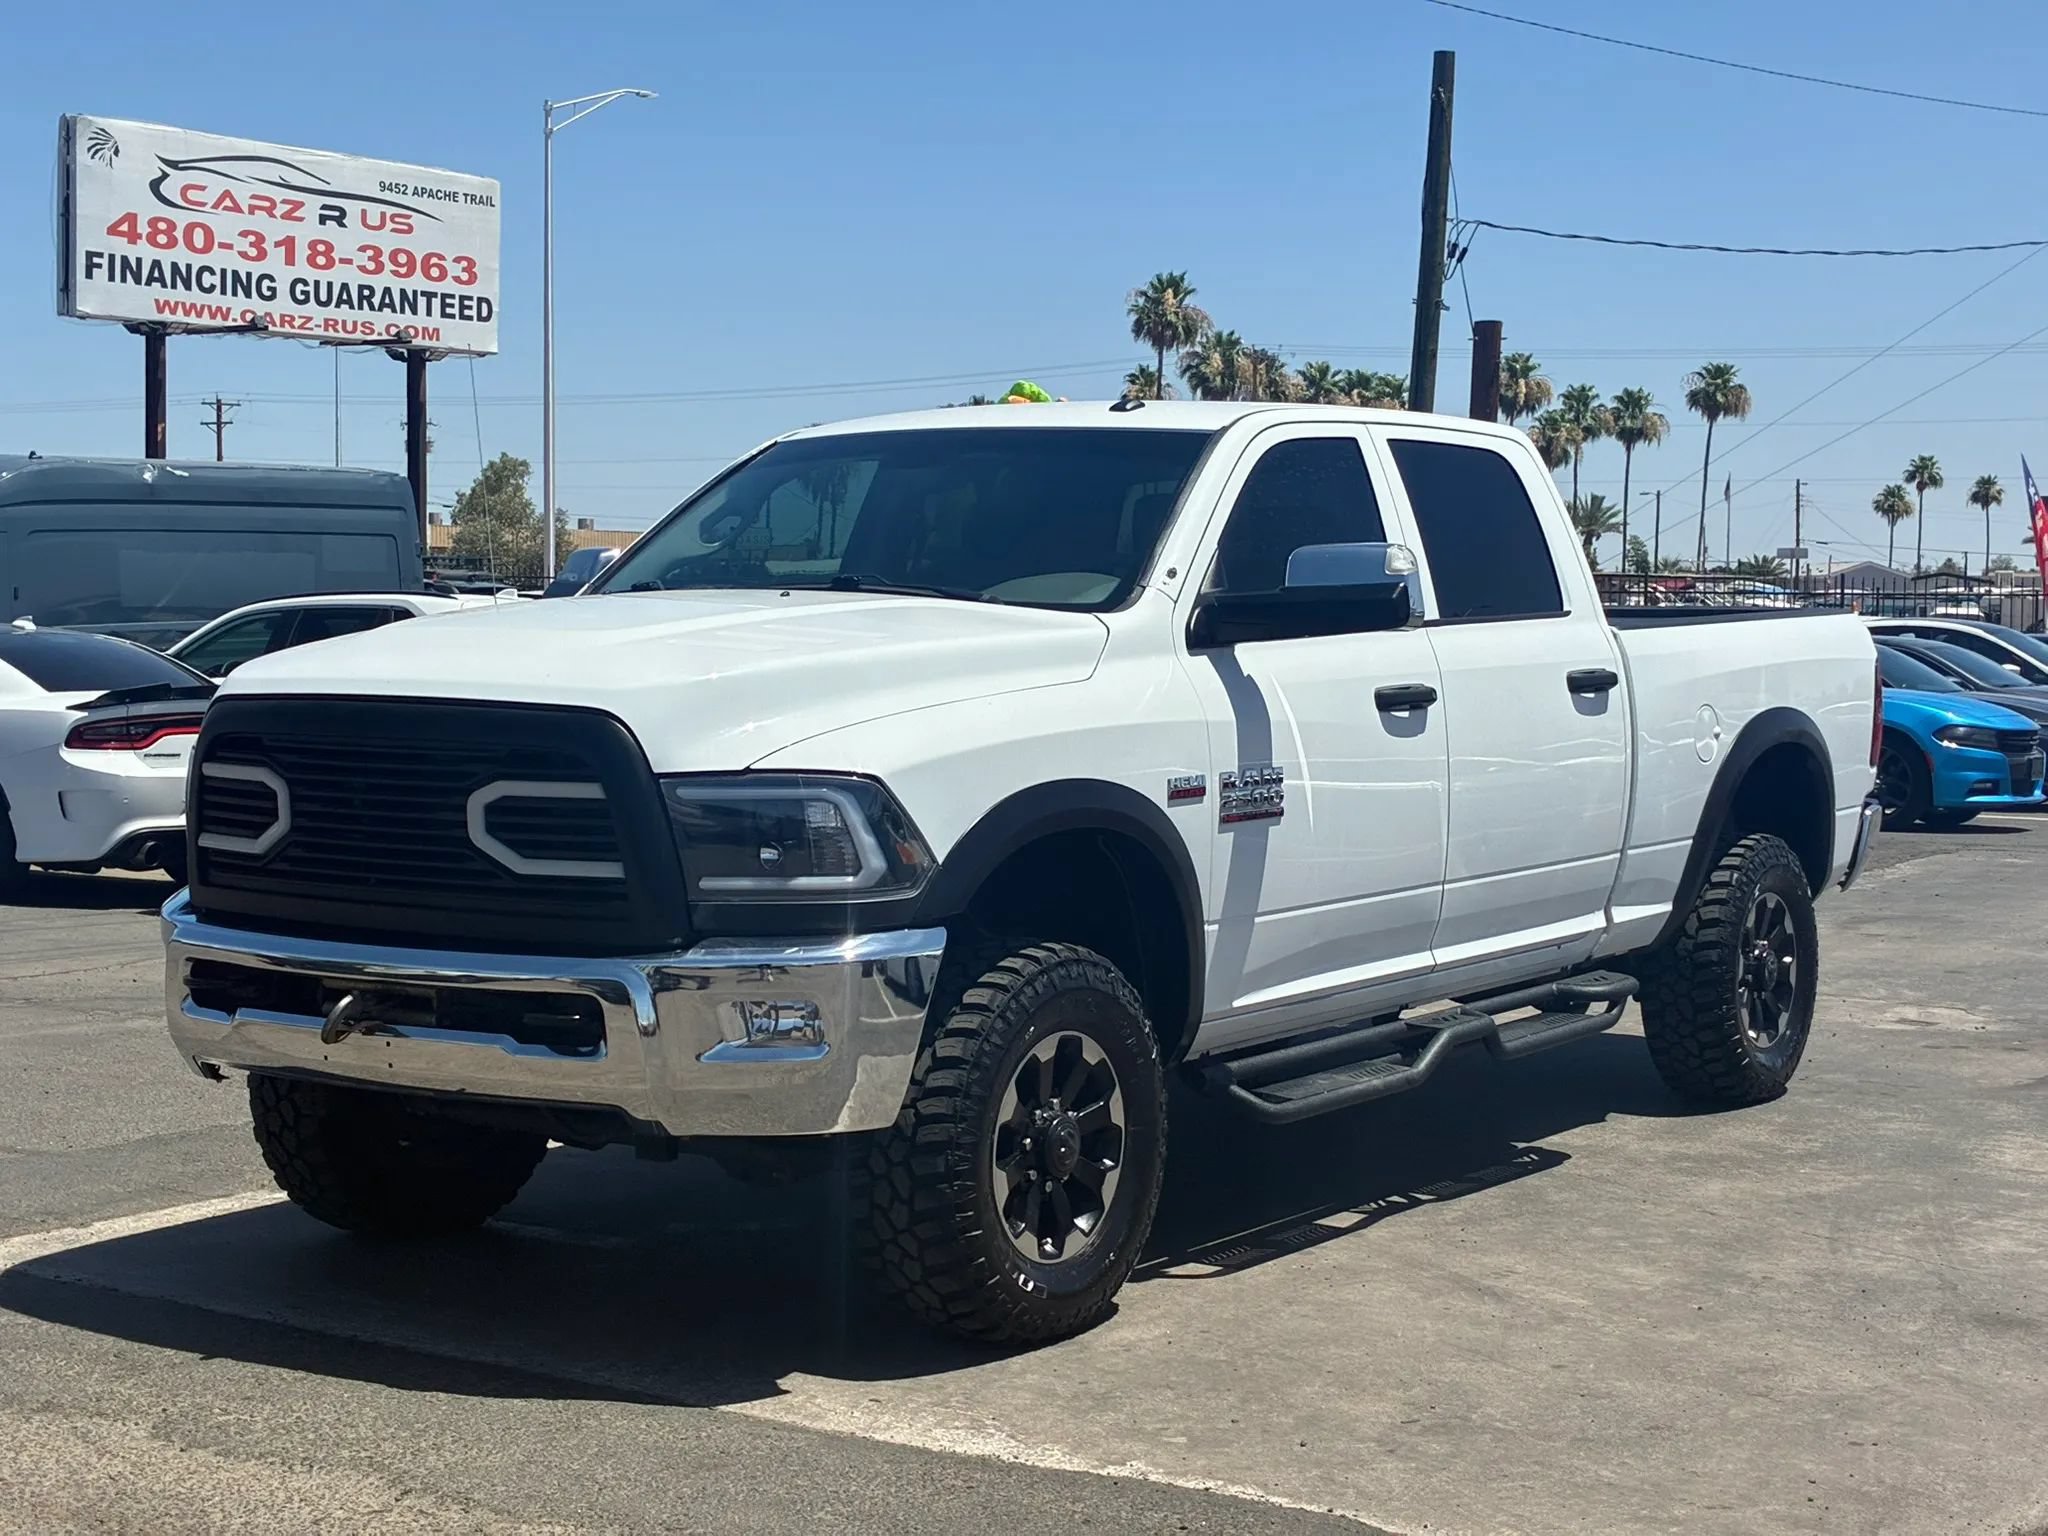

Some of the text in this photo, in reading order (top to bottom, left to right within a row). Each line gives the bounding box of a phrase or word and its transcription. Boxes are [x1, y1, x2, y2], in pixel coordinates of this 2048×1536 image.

[179, 183, 414, 235] CARZ R US
[378, 181, 496, 208] 9452 APACHE TRAIL
[106, 212, 479, 286] 480-318-3963
[84, 250, 493, 323] FINANCING GUARANTEED
[1168, 775, 1205, 789] HEMI
[1220, 767, 1284, 788] RAM
